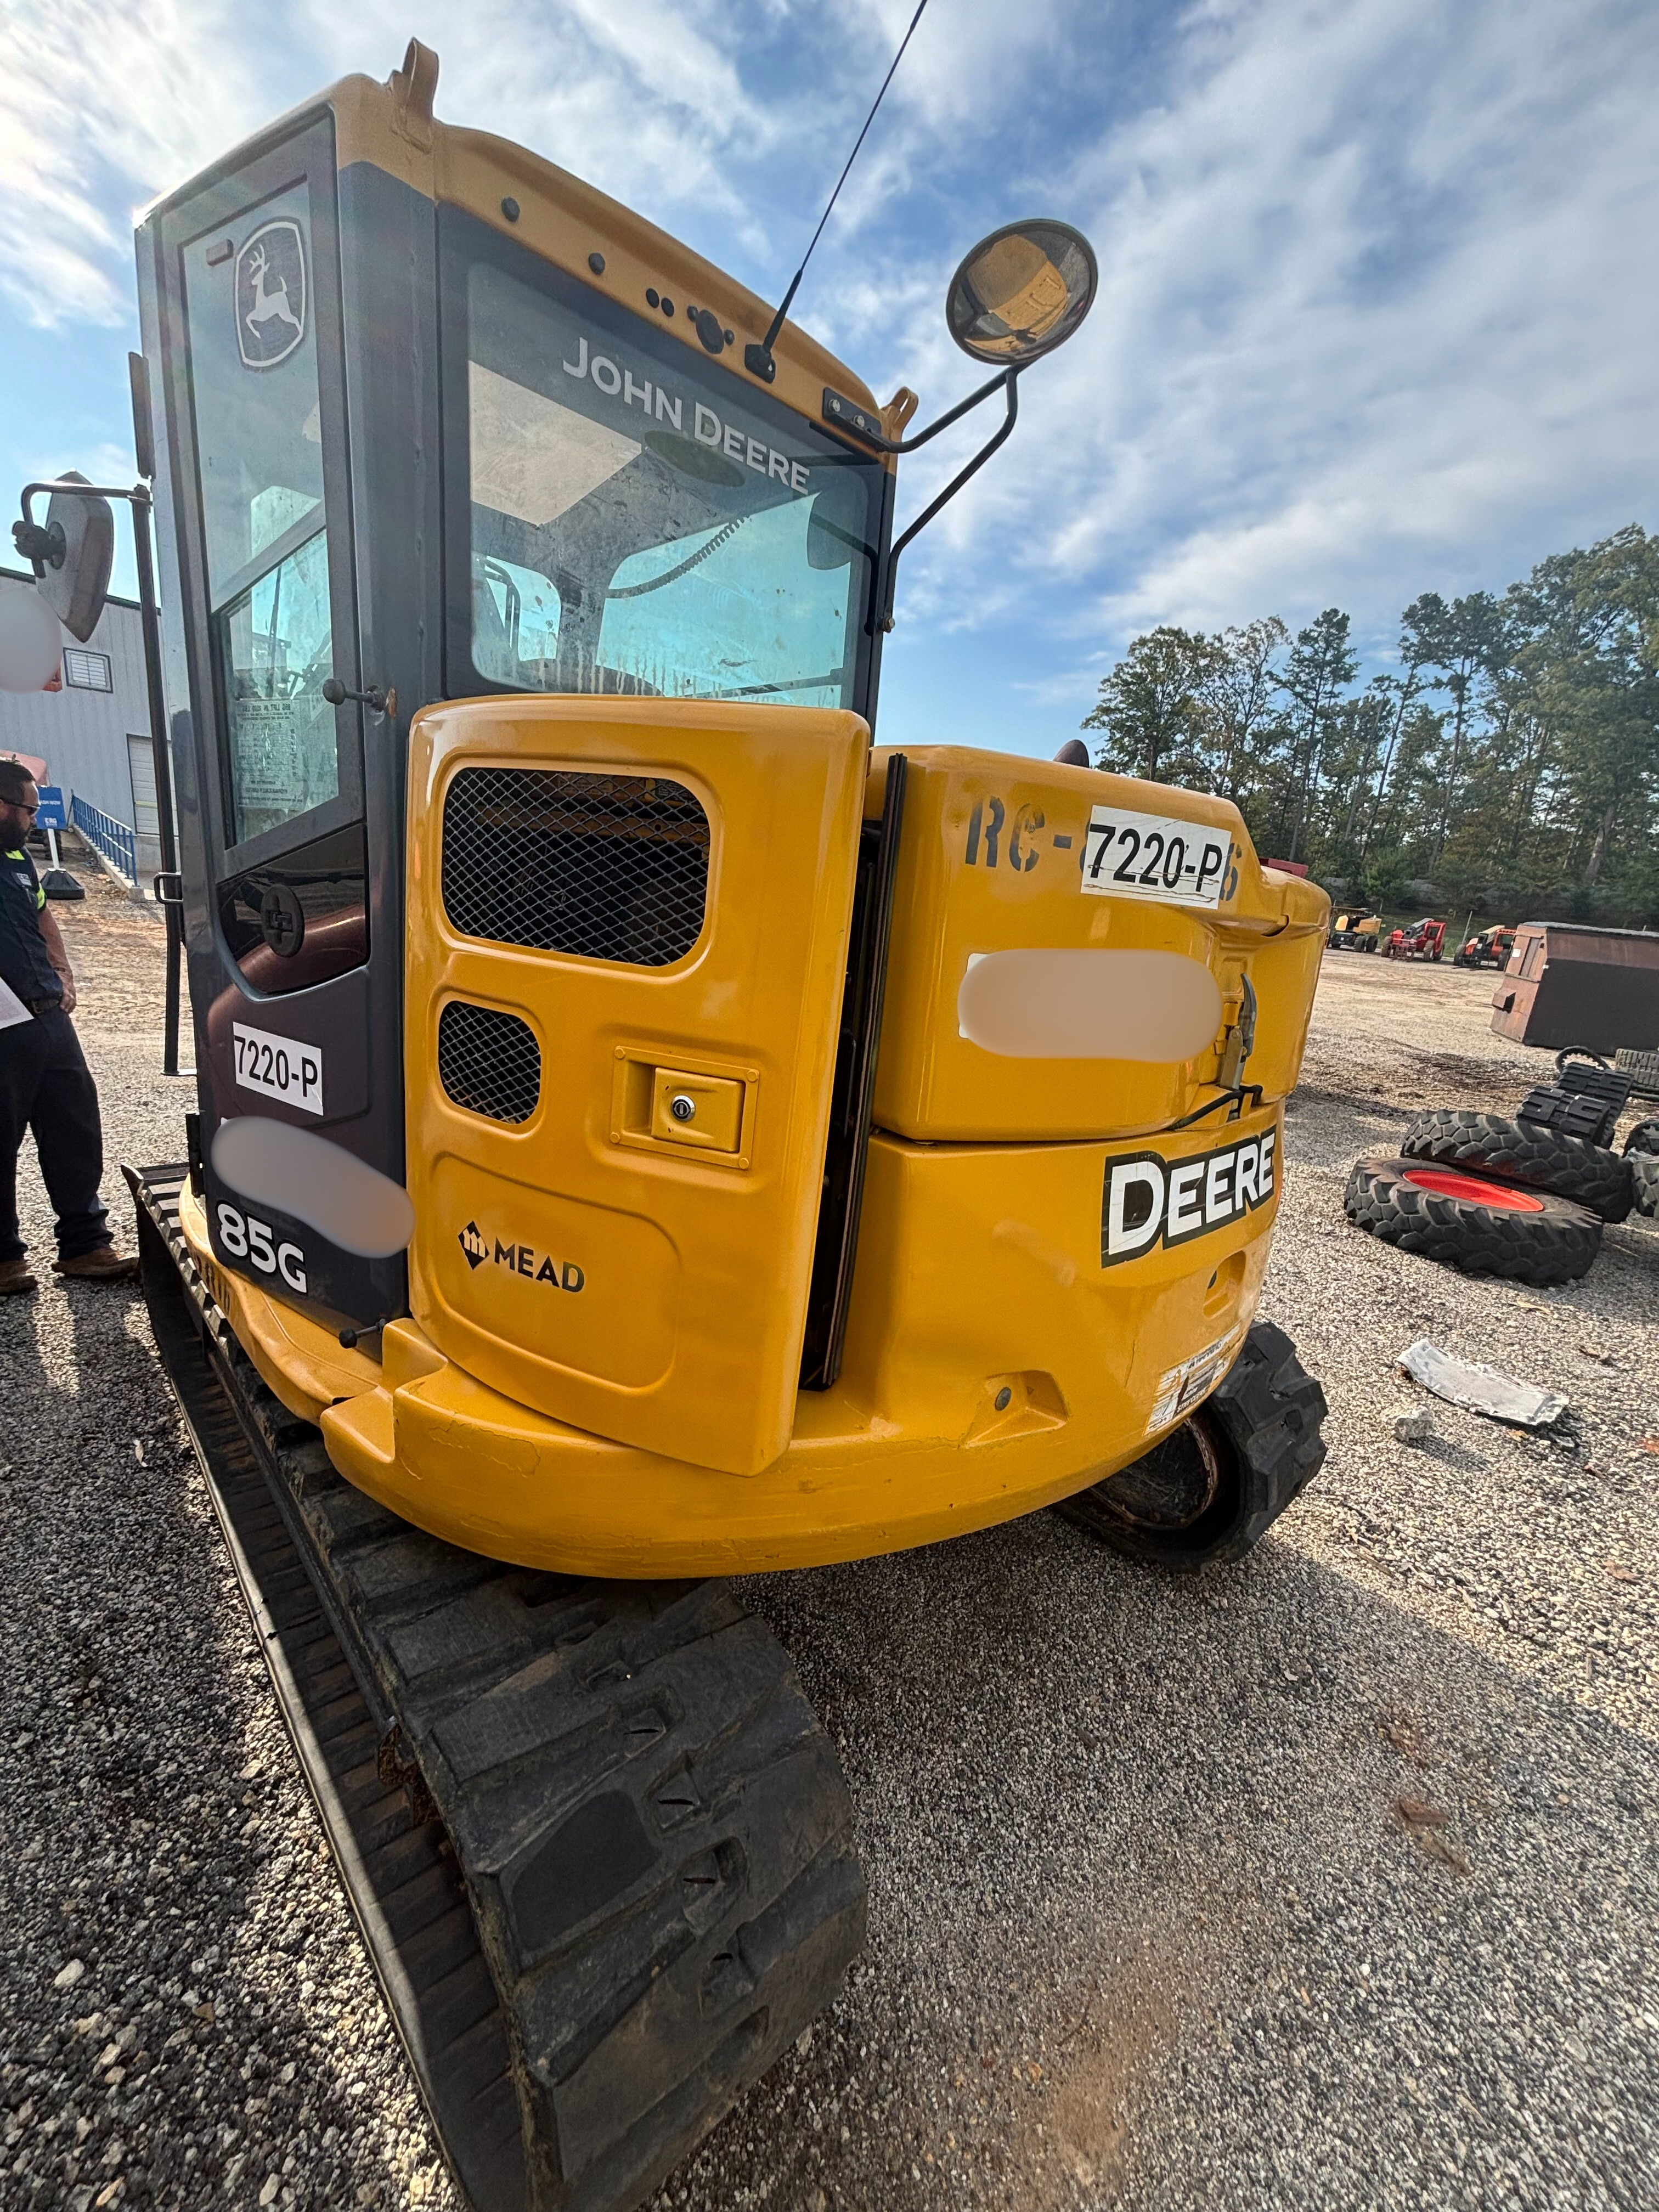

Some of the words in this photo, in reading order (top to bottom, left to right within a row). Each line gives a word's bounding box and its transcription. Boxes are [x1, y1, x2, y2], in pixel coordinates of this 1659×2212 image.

[563, 337, 683, 431] JOHN
[694, 402, 810, 495] DEERE
[1089, 823, 1223, 893] 7220-P
[234, 1035, 318, 1097] 7220-P
[1108, 1133, 1276, 1255] DEERE
[217, 1204, 307, 1294] 85G
[494, 1235, 585, 1293] MEAD
